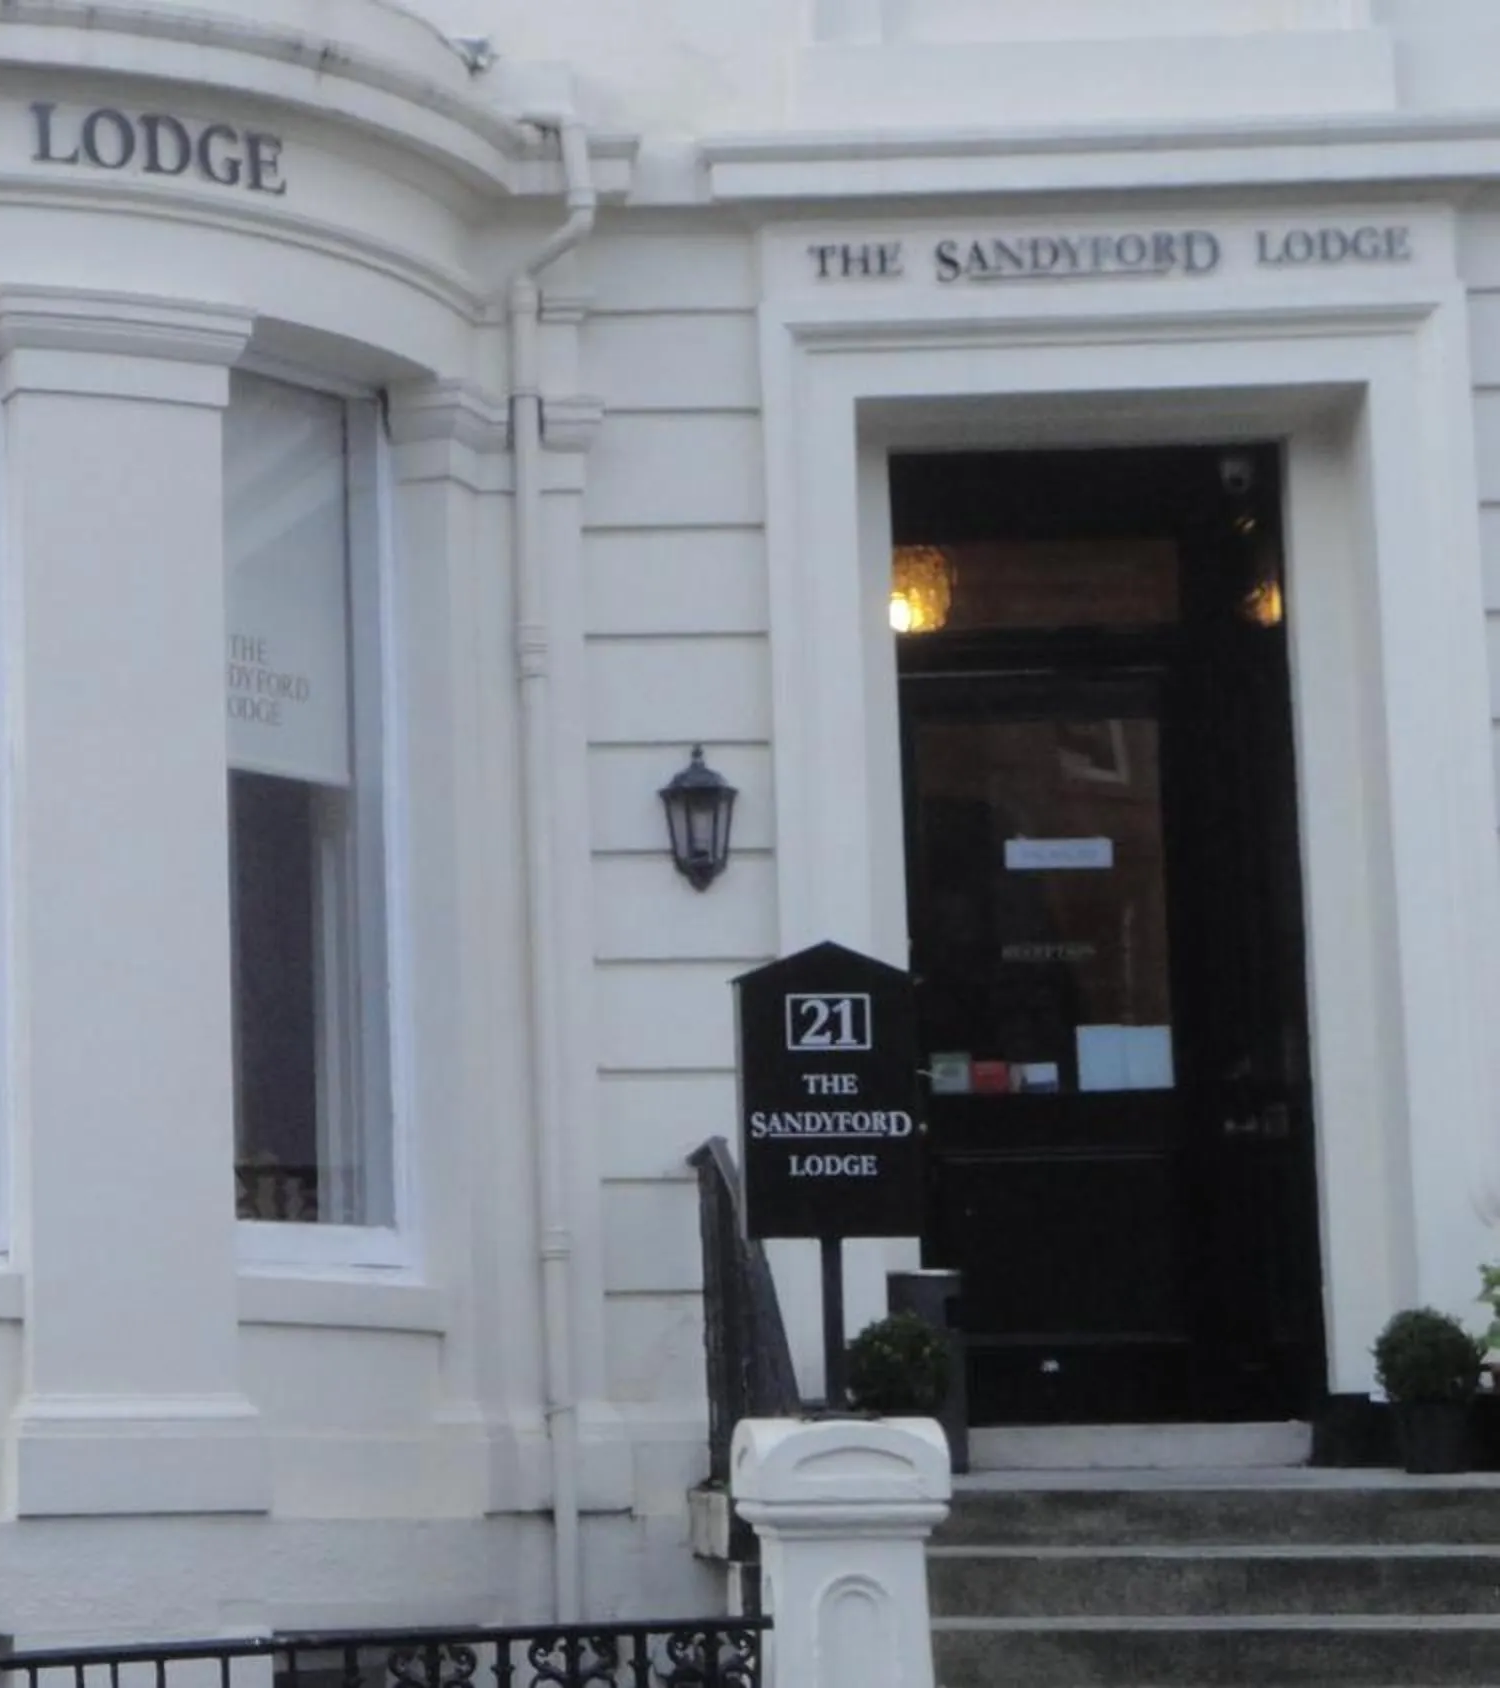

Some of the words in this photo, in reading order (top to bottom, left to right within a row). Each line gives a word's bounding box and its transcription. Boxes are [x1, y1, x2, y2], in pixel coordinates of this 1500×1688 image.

[29, 101, 288, 195] LODGE
[807, 242, 902, 278] THE
[934, 229, 1220, 283] SANDYFORD
[1255, 226, 1411, 264] LODGE
[226, 633, 268, 662] THE
[800, 1000, 858, 1045] 21
[802, 1073, 858, 1095] THE
[750, 1111, 913, 1138] SANDYFORD
[788, 1155, 878, 1177] LODGE
